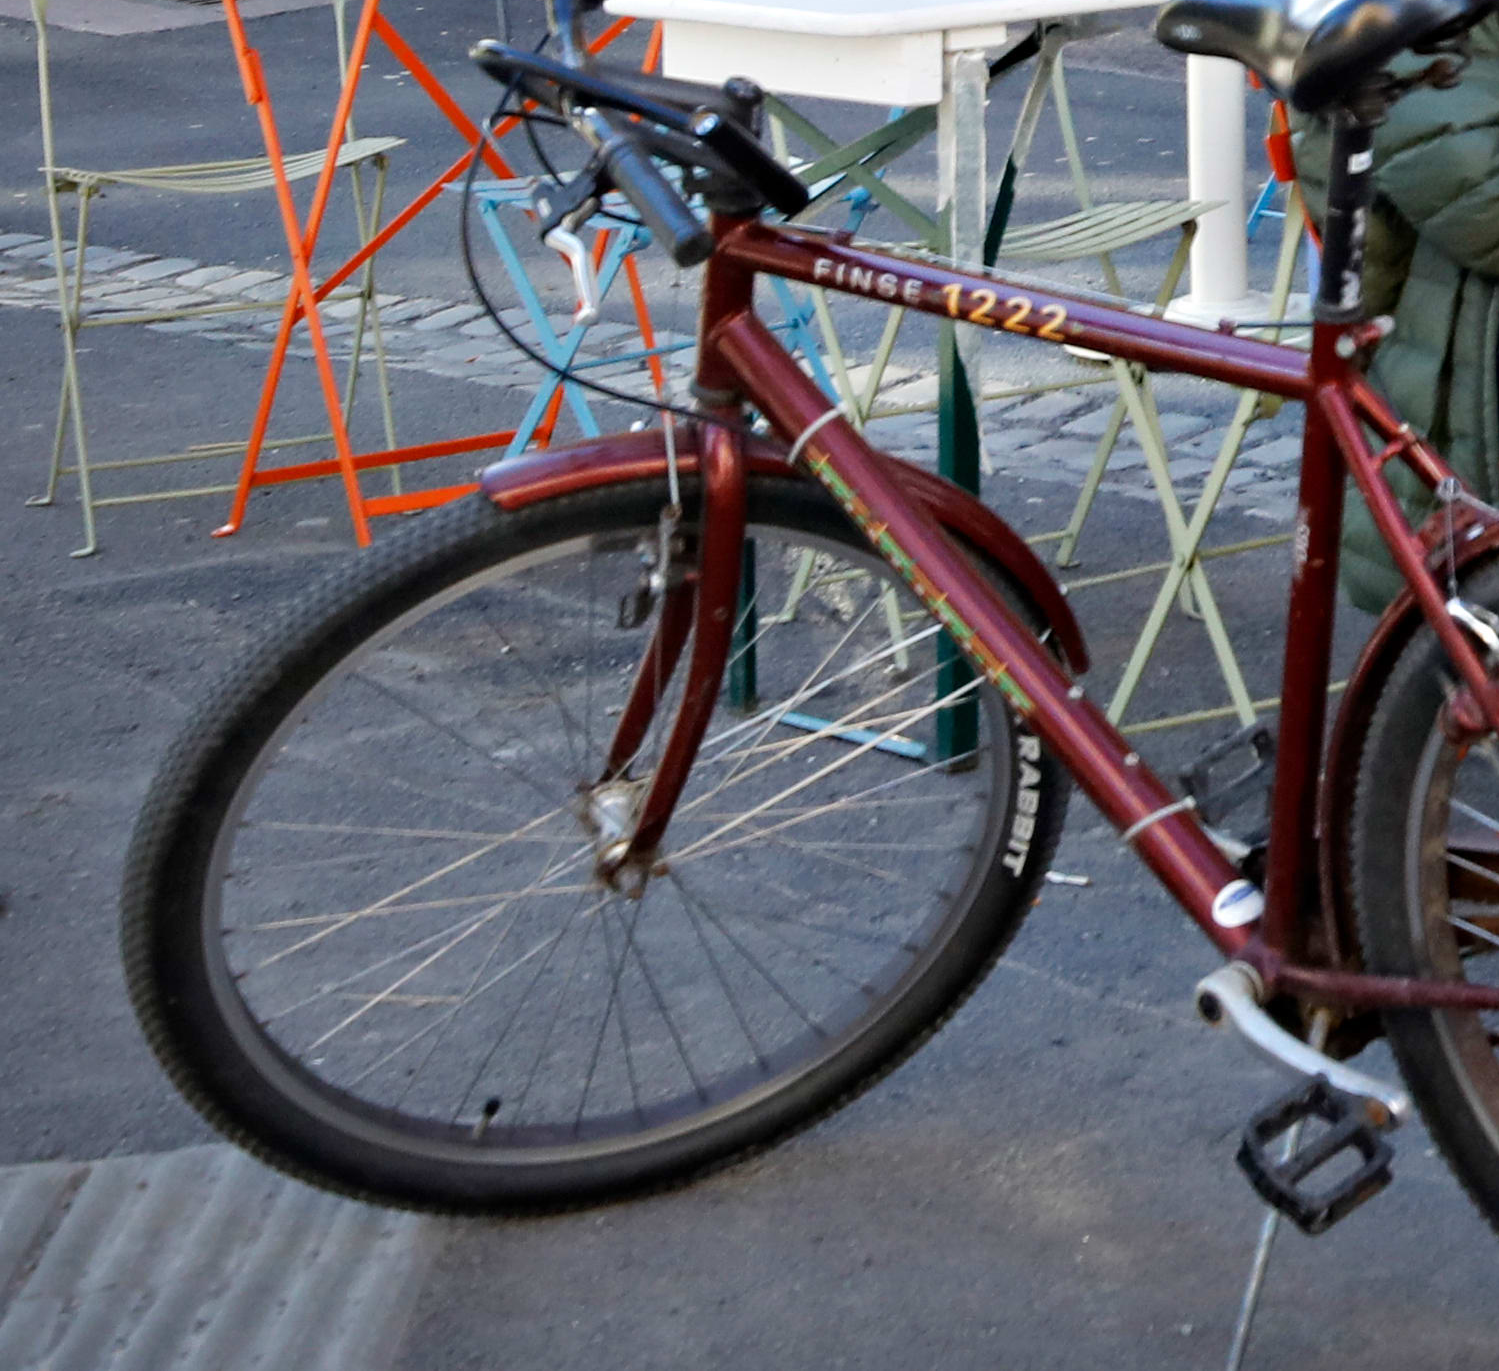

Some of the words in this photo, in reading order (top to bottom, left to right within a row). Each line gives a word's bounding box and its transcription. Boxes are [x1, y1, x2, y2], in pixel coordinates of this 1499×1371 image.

[812, 256, 924, 304] FINSE
[942, 282, 1067, 342] 1222
[1002, 735, 1041, 878] RABBIT
